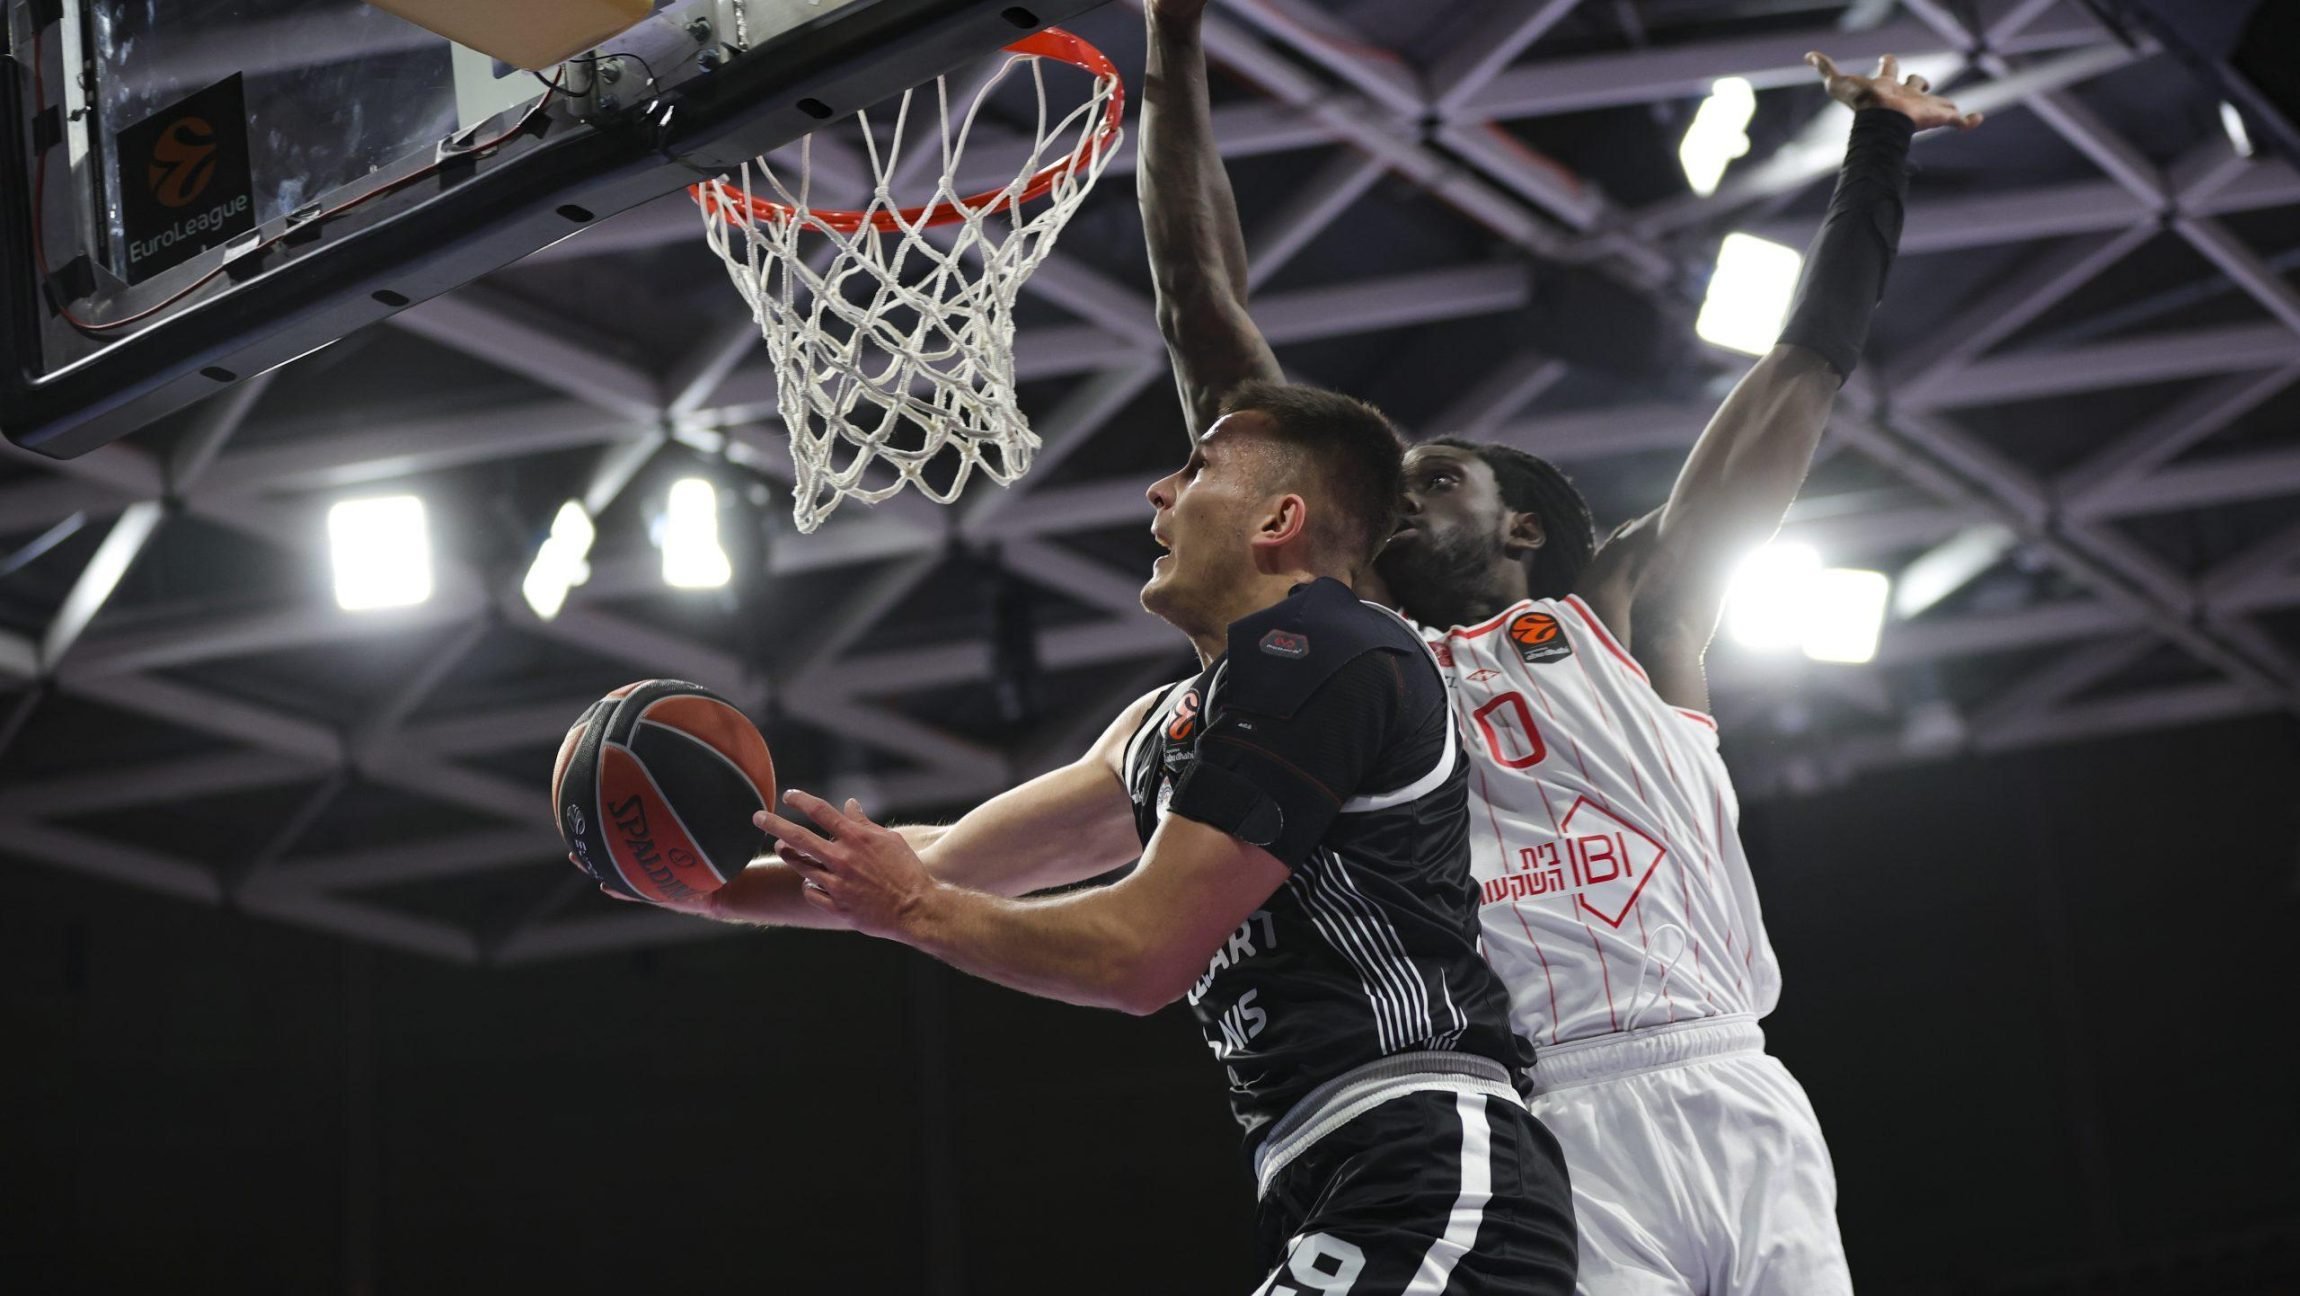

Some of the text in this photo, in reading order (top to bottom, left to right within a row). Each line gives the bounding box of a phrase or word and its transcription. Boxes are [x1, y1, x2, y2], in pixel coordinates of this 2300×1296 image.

[130, 195, 248, 263] EuroLeague
[1473, 691, 1547, 770] 0
[608, 794, 708, 898] SPALDIN
[1519, 842, 1561, 870] בית
[1565, 831, 1633, 887] IBI
[1251, 1232, 1367, 1296] 9
